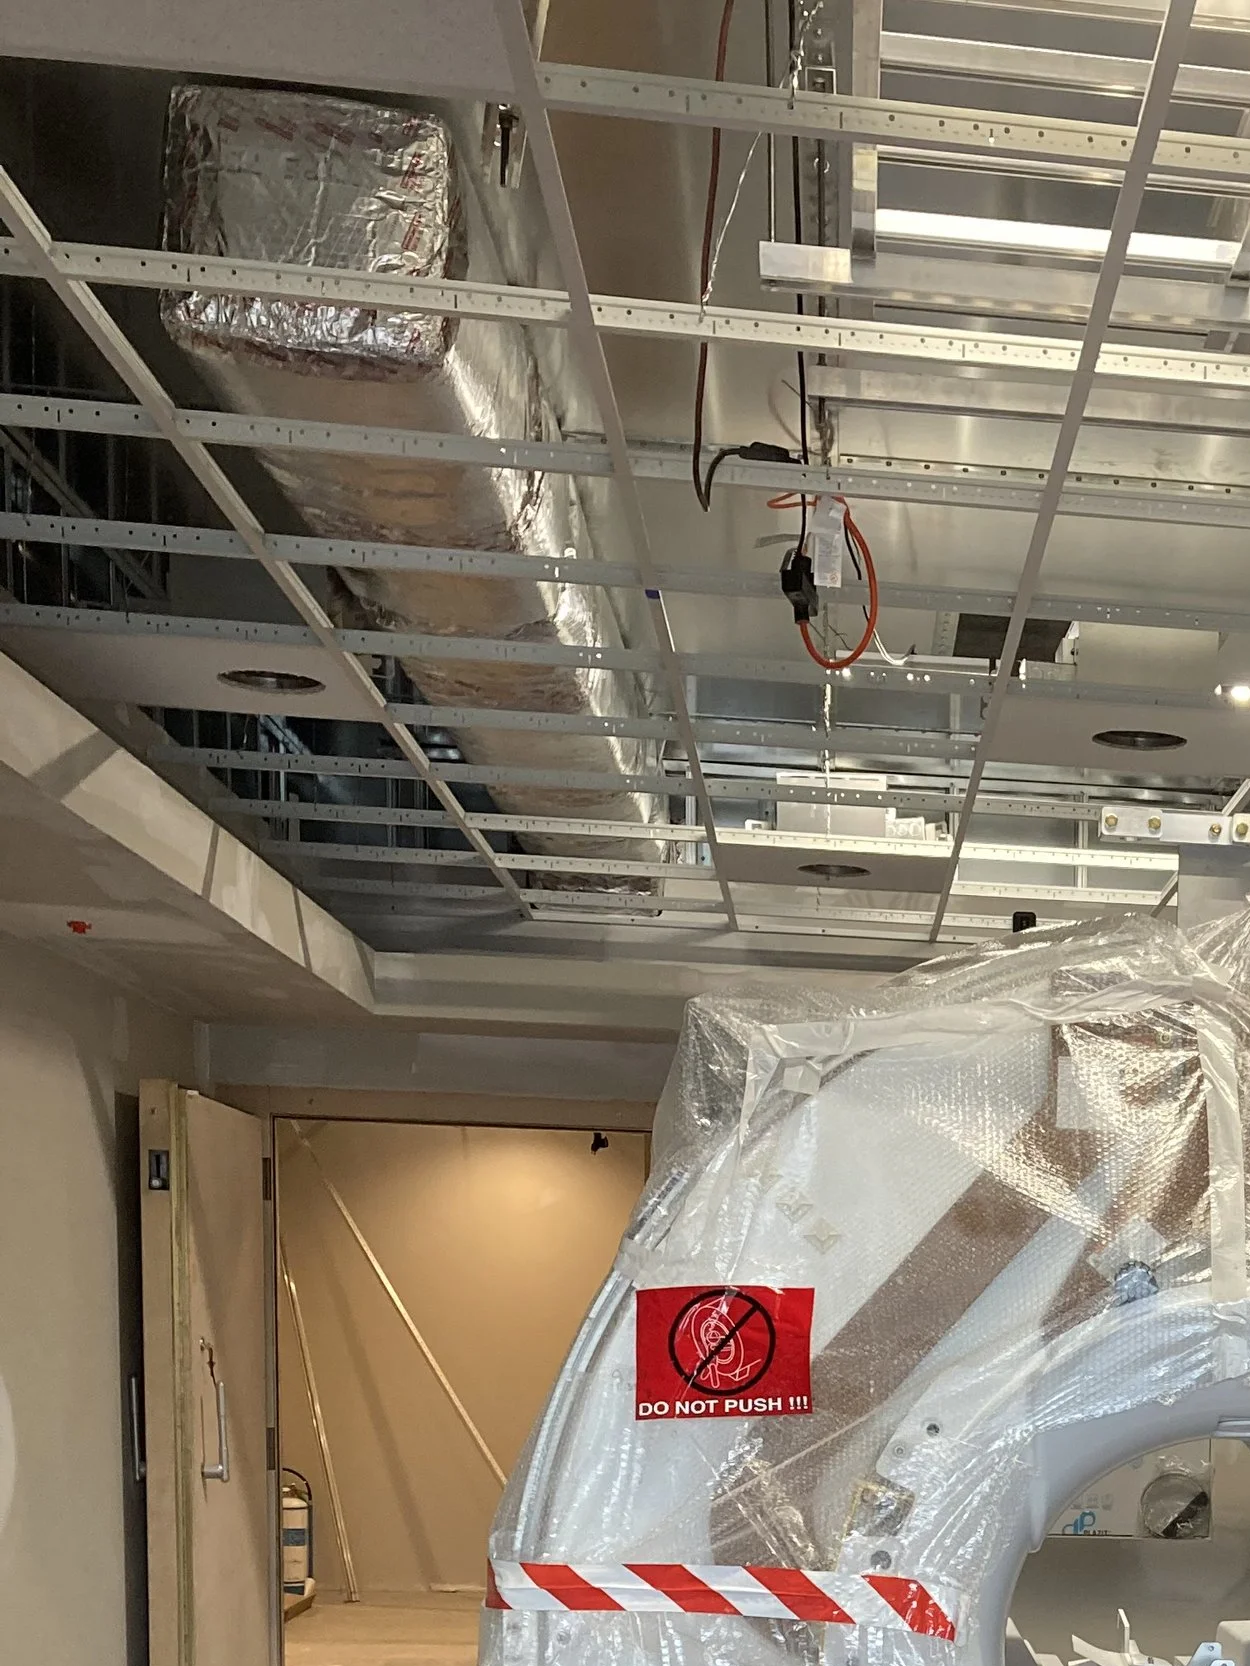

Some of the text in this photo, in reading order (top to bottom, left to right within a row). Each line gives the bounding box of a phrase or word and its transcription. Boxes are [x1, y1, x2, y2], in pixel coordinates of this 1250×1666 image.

[638, 1395, 809, 1416] DO NOT PUSH !!!
